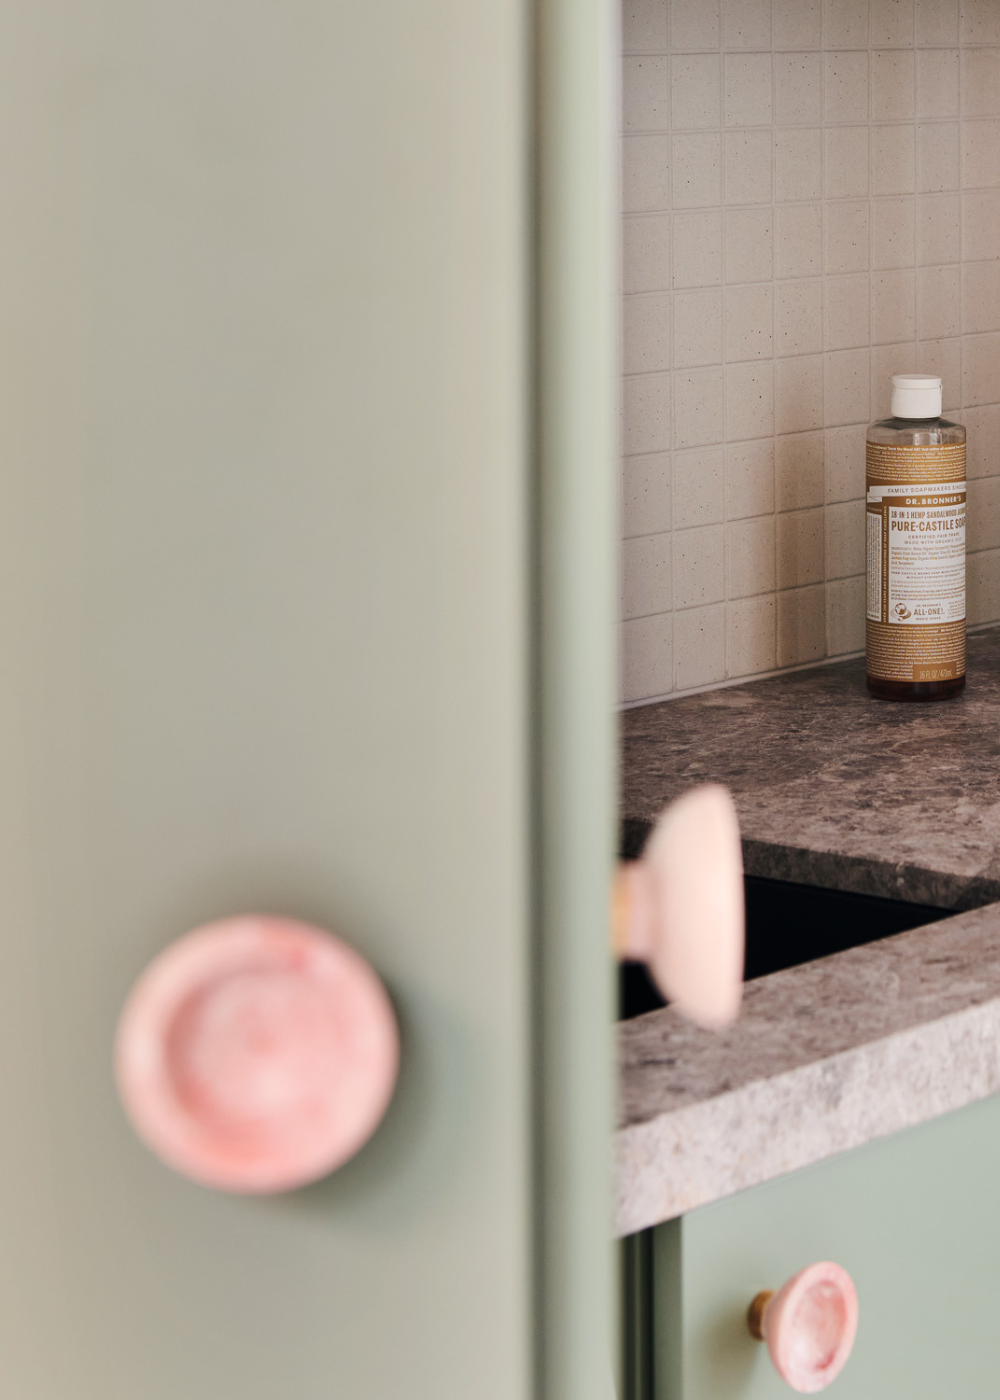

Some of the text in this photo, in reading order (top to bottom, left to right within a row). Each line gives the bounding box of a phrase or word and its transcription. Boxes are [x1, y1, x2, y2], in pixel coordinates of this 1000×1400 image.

[921, 495, 962, 505] BRONNER'S
[910, 511, 925, 519] HEMP
[926, 509, 957, 519] SANDALWOOD
[891, 519, 954, 532] PURE-CASTILE
